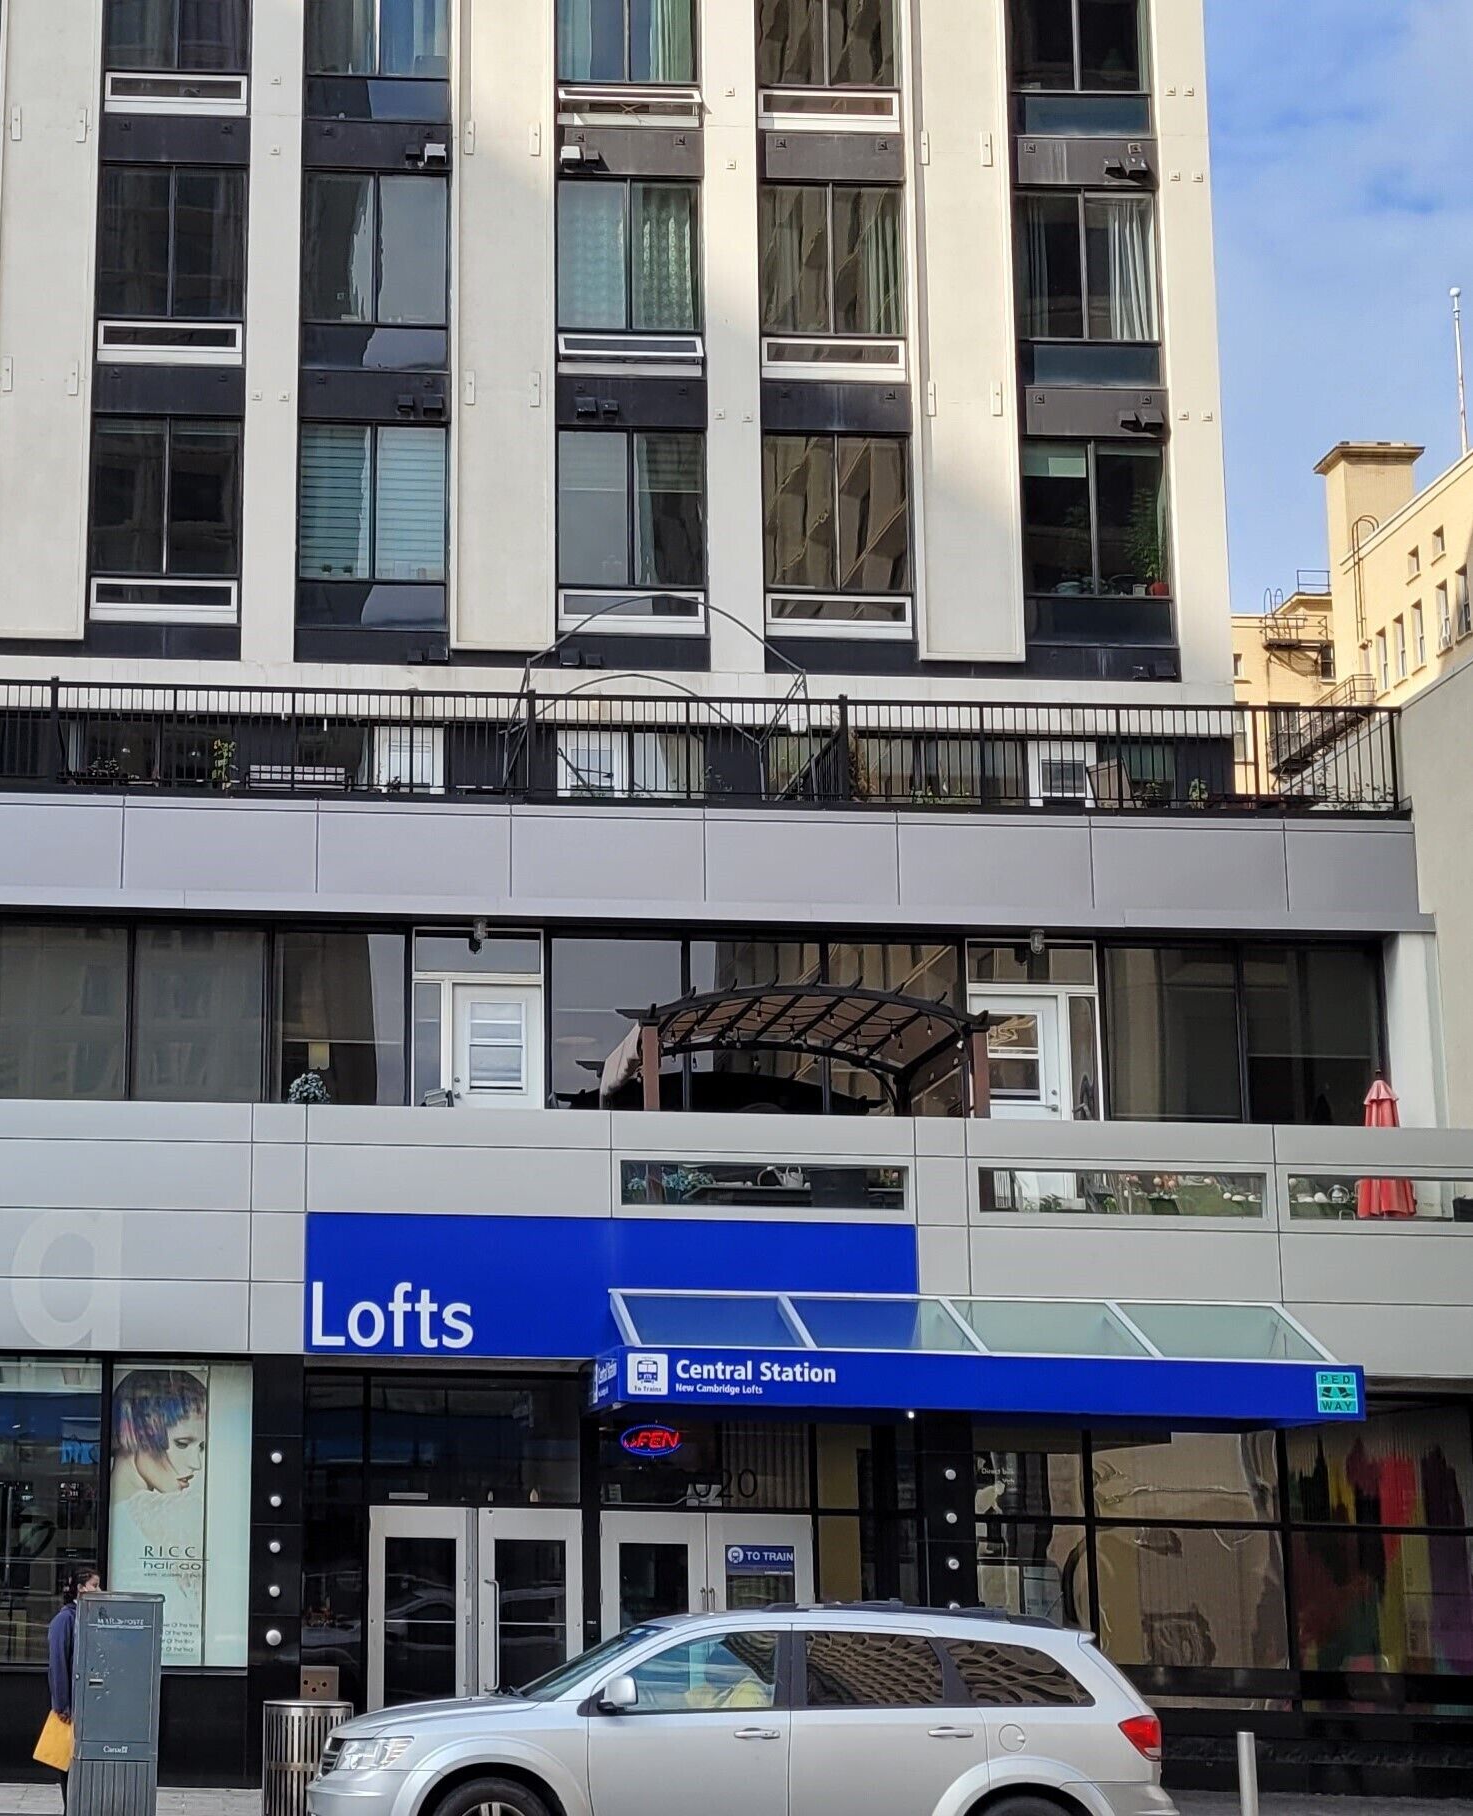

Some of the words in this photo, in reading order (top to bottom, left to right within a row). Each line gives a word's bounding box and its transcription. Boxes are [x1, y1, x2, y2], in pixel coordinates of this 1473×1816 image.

[311, 1281, 475, 1349] Lofts
[676, 1359, 753, 1380] Central
[760, 1362, 836, 1383] Station
[1320, 1374, 1351, 1385] PED
[675, 1383, 694, 1392] New
[696, 1384, 740, 1395] Cambridge
[742, 1385, 763, 1394] Lofts
[1322, 1400, 1352, 1411] WAY
[144, 1545, 197, 1558] RICC
[746, 1551, 761, 1561] TO
[763, 1551, 794, 1563] TRAIN
[144, 1560, 174, 1570] hair
